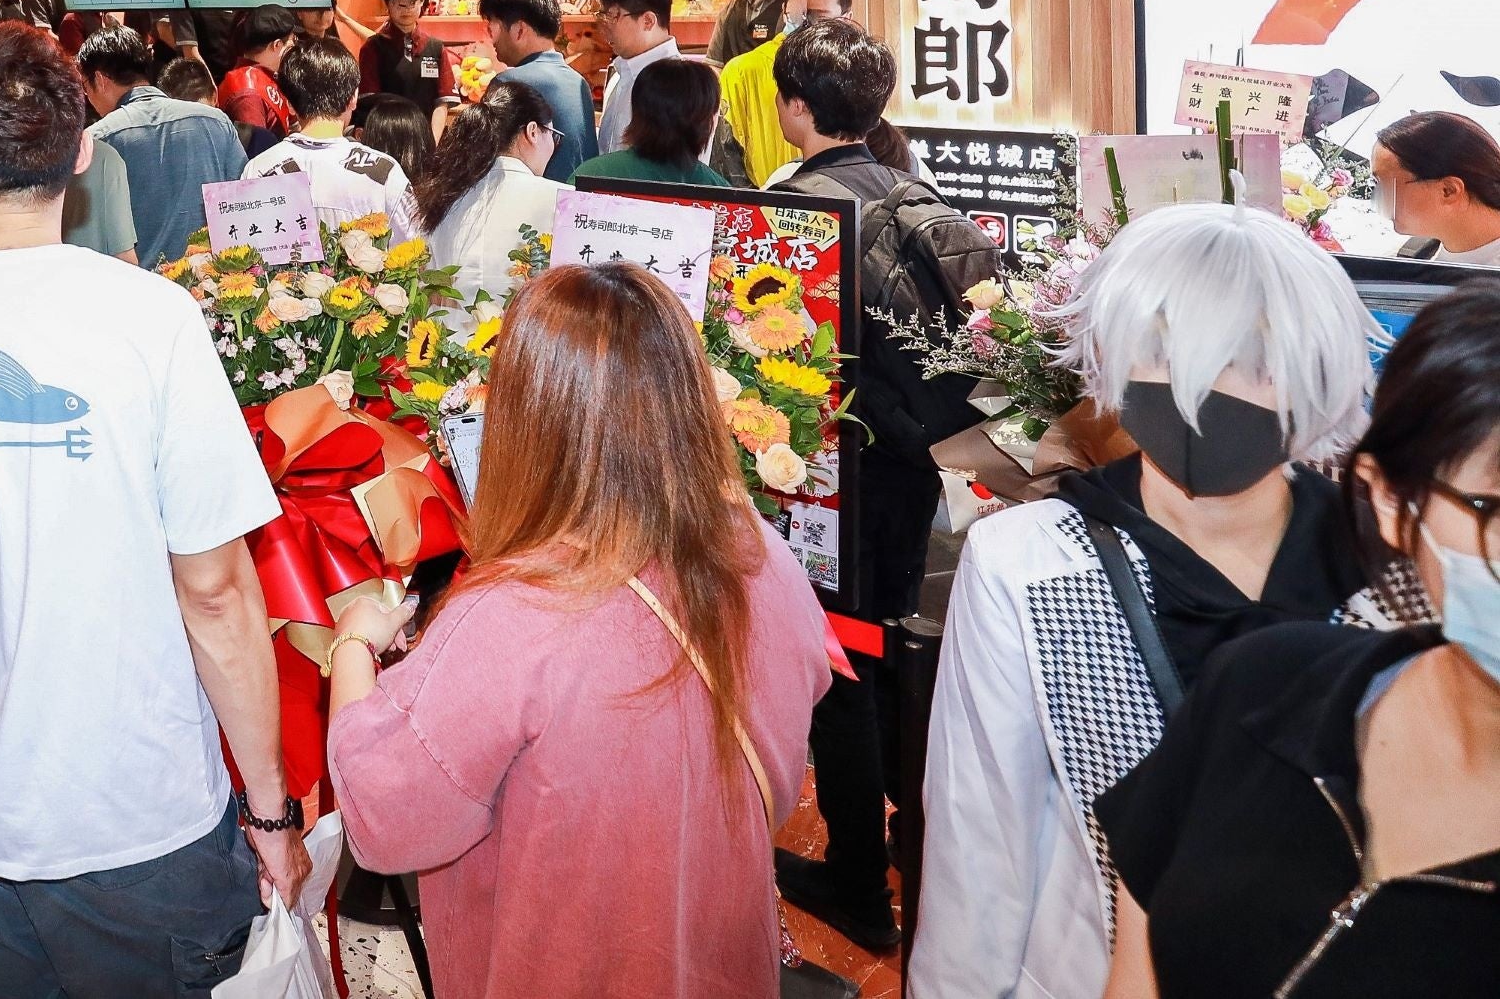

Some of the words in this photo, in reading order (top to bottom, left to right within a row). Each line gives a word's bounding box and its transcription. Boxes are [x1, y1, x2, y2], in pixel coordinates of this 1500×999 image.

[1191, 82, 1293, 107] 生意兴隆
[1188, 97, 1290, 122] 财广进
[228, 213, 308, 241] 开业大吉
[574, 213, 674, 241] 祝寿司郎北京一号店
[775, 207, 835, 230] 日本高人气
[778, 219, 827, 240] 回转寿司
